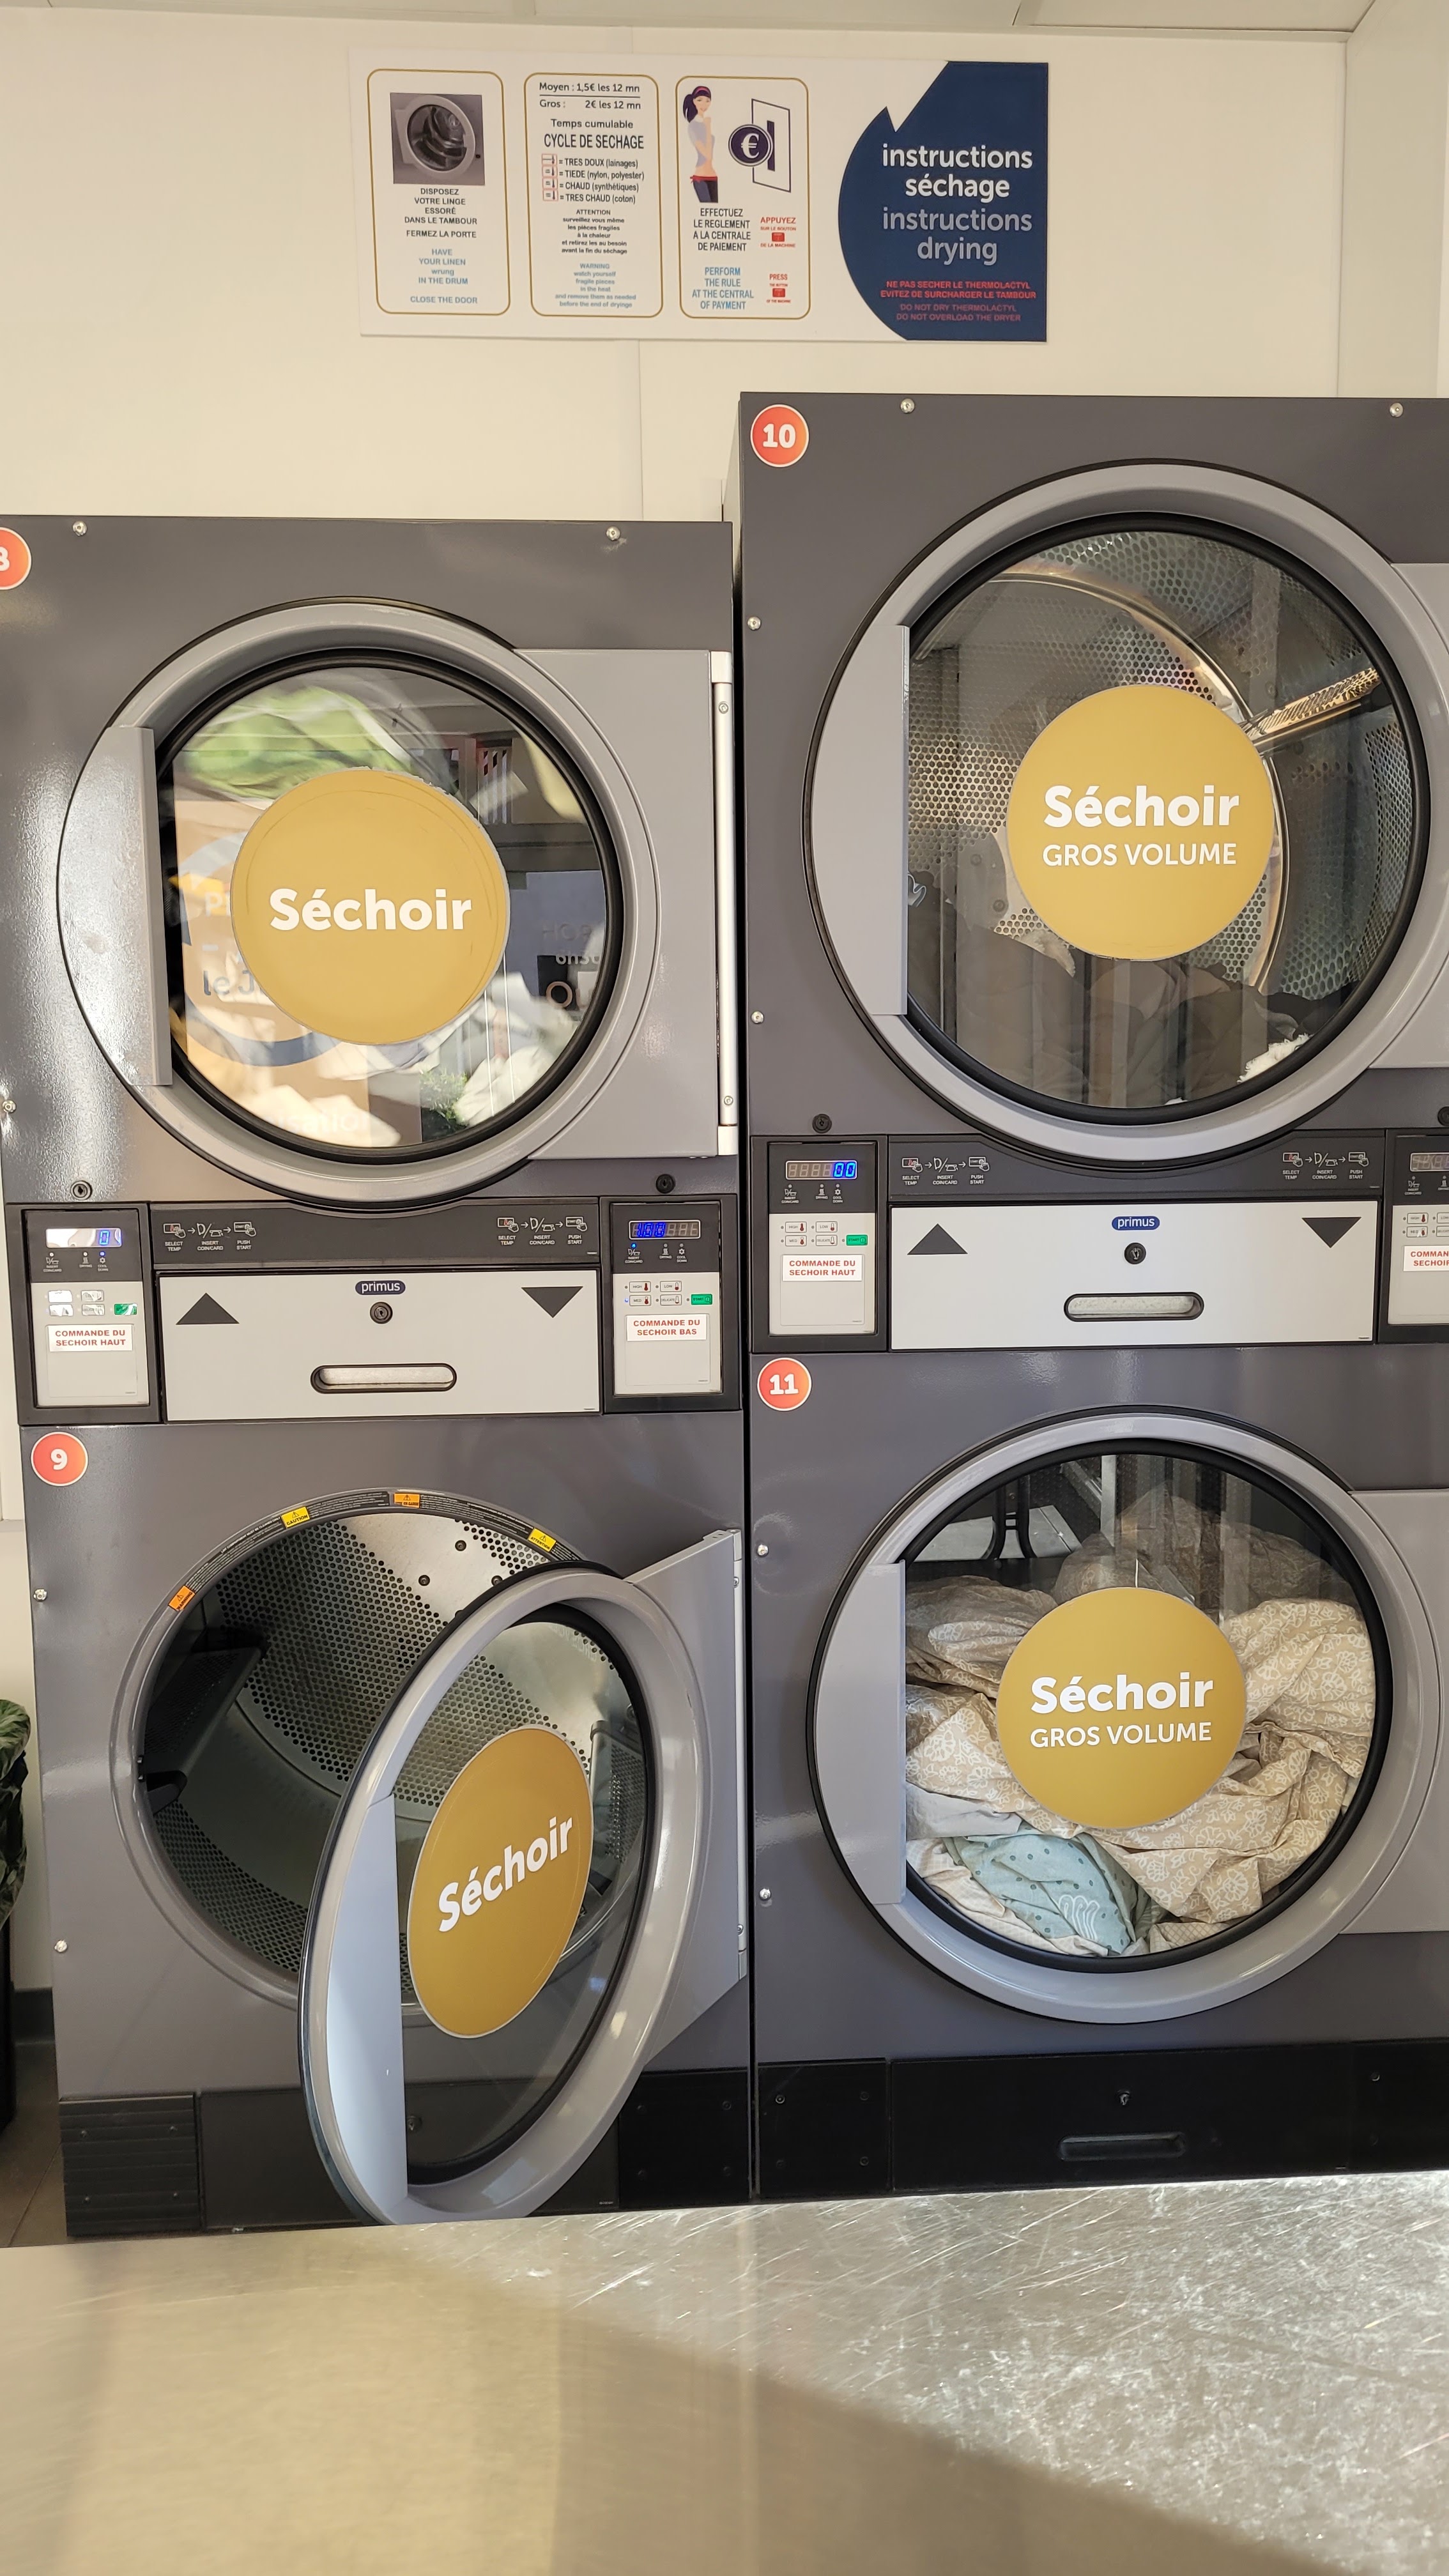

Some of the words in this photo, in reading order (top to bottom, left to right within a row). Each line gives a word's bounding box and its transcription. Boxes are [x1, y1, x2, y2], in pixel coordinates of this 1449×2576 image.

[883, 143, 1032, 168] instructions
[906, 174, 1009, 203] séchage
[701, 208, 743, 217] EFFECTUEZ
[884, 207, 1032, 231] instructions
[694, 219, 702, 227] LE
[705, 220, 750, 228] REGLEMENT
[693, 231, 698, 239] A
[701, 231, 709, 239] LA
[712, 231, 751, 240] CENTRALE
[698, 242, 707, 250] DE
[710, 243, 746, 251] PAIEMENT
[917, 236, 997, 265] drying
[705, 267, 740, 275] PERFORM
[693, 289, 700, 298] AT
[703, 289, 717, 298] THE
[720, 290, 754, 298] CENTRAL
[722, 279, 740, 287] RULE
[917, 281, 951, 290] SECHER
[700, 301, 709, 309] OF
[713, 301, 746, 309] PAYMENT
[763, 423, 796, 448] 10
[1044, 785, 1239, 828] Séchoir
[1043, 843, 1117, 866] GROS
[1124, 843, 1237, 866] VOLUME
[269, 888, 472, 930] Séchoir
[1117, 1216, 1155, 1229] primus
[361, 1281, 401, 1293] primus
[769, 1374, 799, 1395] 11
[50, 1448, 68, 1470] 9
[286, 1515, 309, 1526] CAUTION
[1031, 1672, 1213, 1713] Séchoir
[1030, 1726, 1100, 1747] GROS
[1106, 1722, 1211, 1744] VOLUME
[439, 1816, 572, 1932] Séchoir
